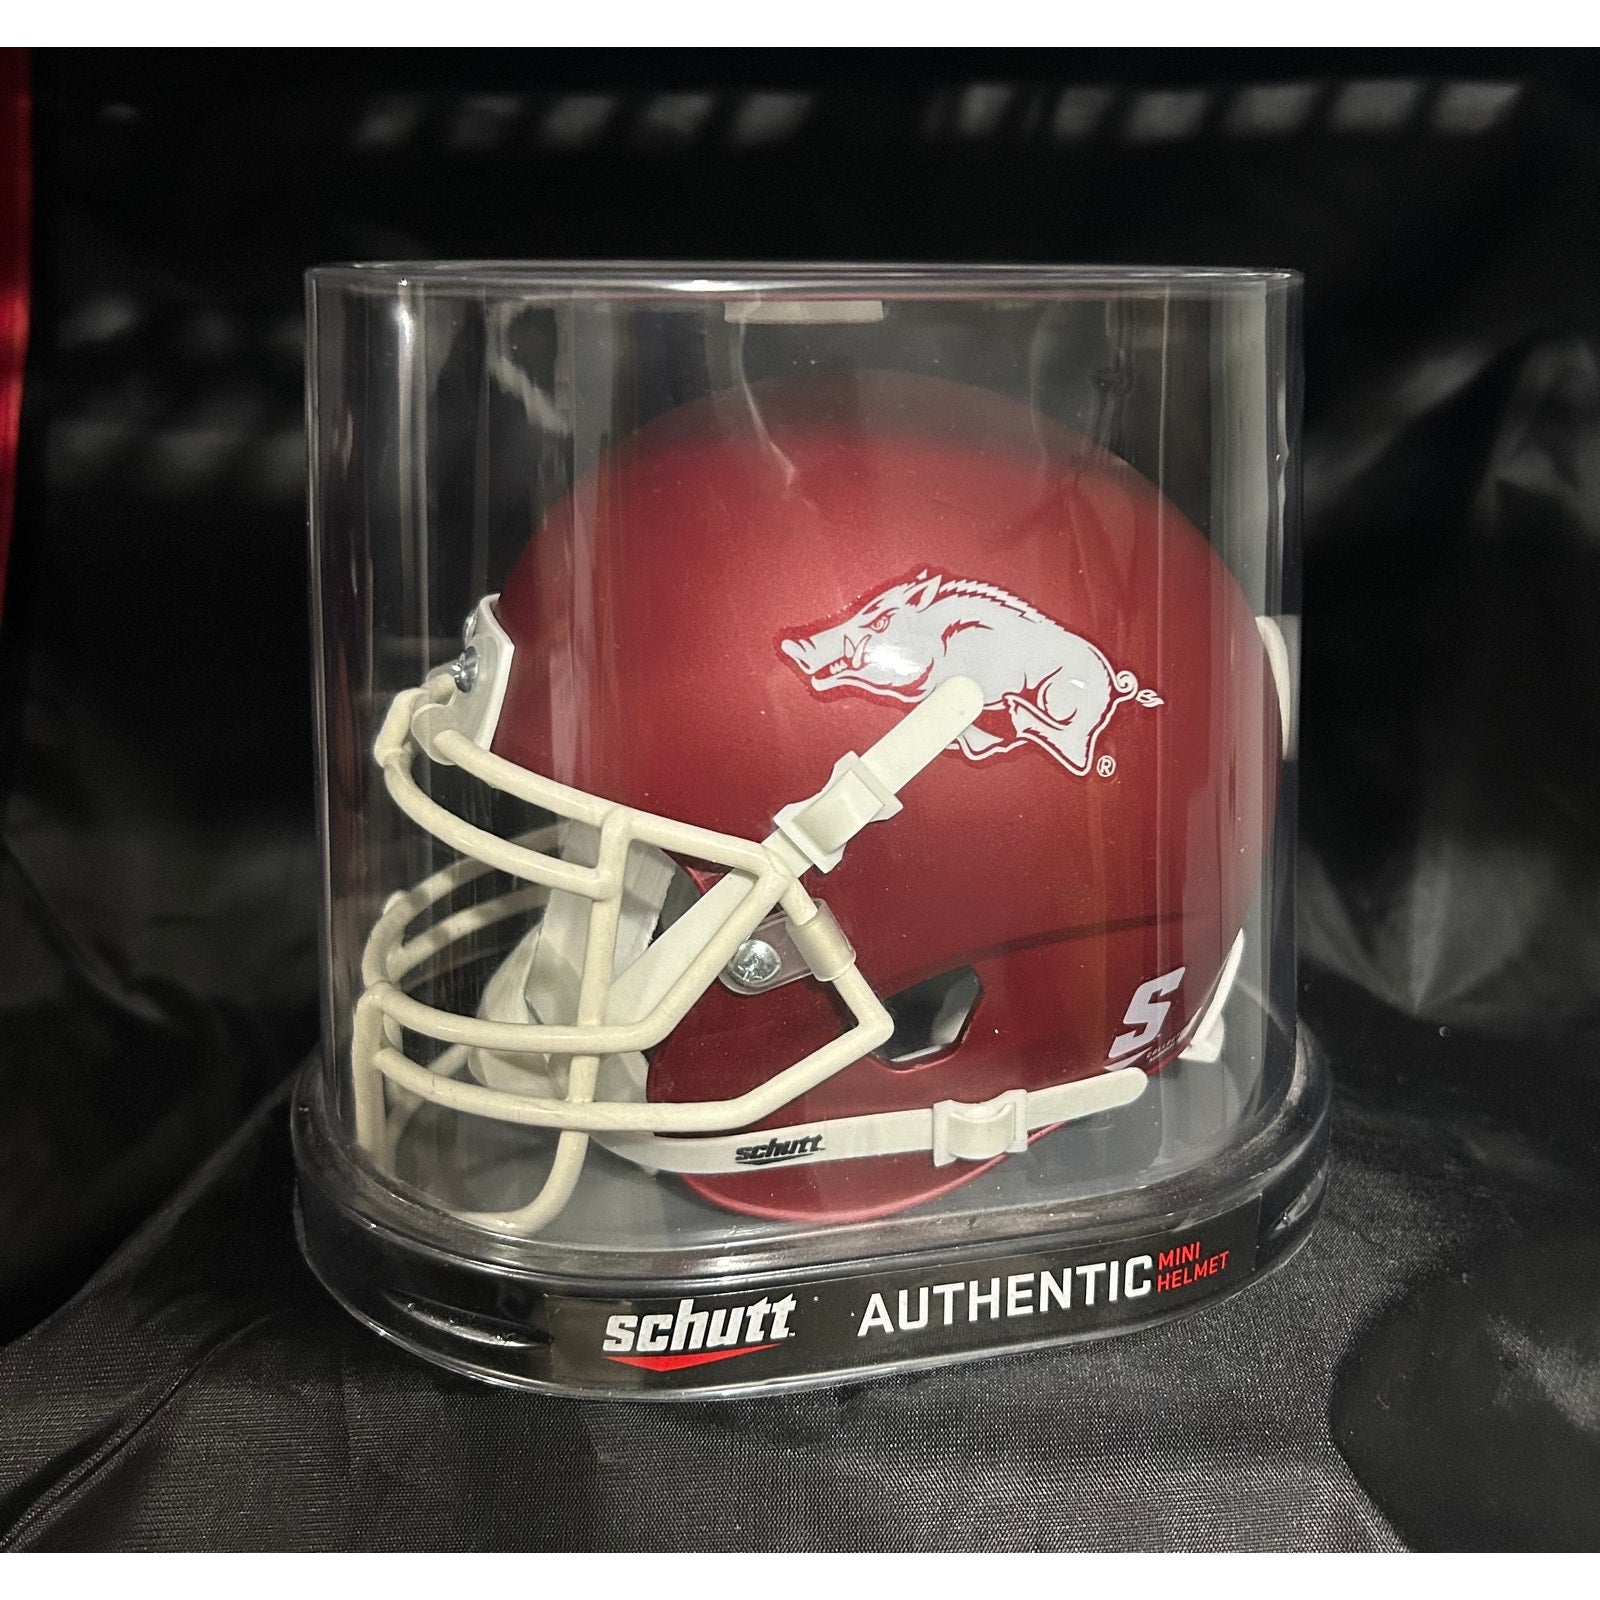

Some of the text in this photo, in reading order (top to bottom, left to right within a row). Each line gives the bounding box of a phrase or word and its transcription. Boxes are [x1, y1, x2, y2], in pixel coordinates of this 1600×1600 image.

[1108, 966, 1186, 1059] S
[735, 1134, 823, 1161] schutt
[1157, 1250, 1230, 1293] HELMET
[1158, 1241, 1201, 1271] MINI
[857, 1254, 1153, 1337] AUTHENTIC
[602, 1295, 796, 1353] schutt
